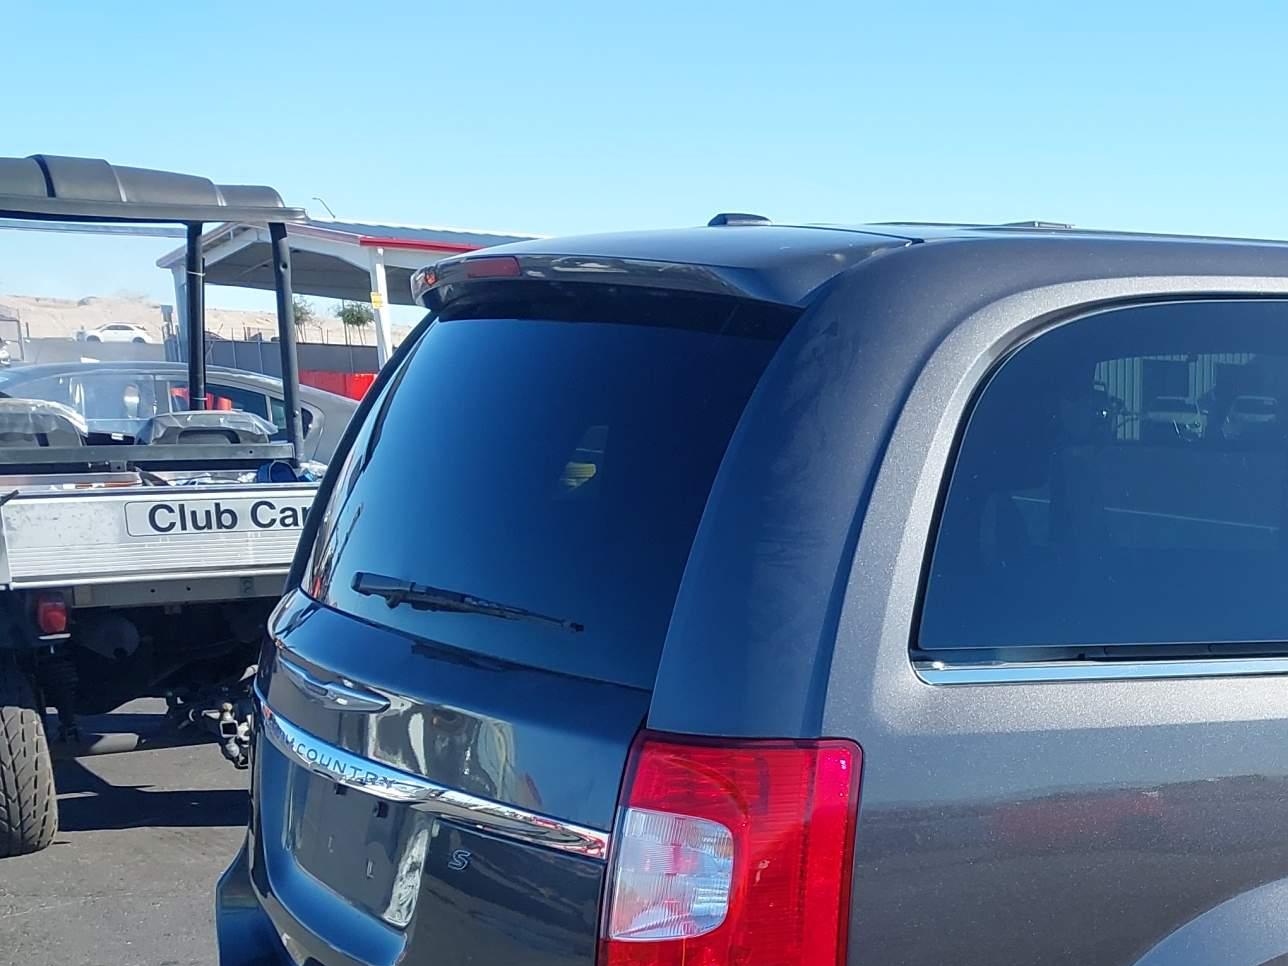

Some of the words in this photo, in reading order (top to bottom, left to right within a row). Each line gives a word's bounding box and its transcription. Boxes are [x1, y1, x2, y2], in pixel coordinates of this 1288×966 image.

[148, 503, 239, 533] Club
[296, 742, 395, 791] COUNTRY
[447, 849, 472, 871] S
